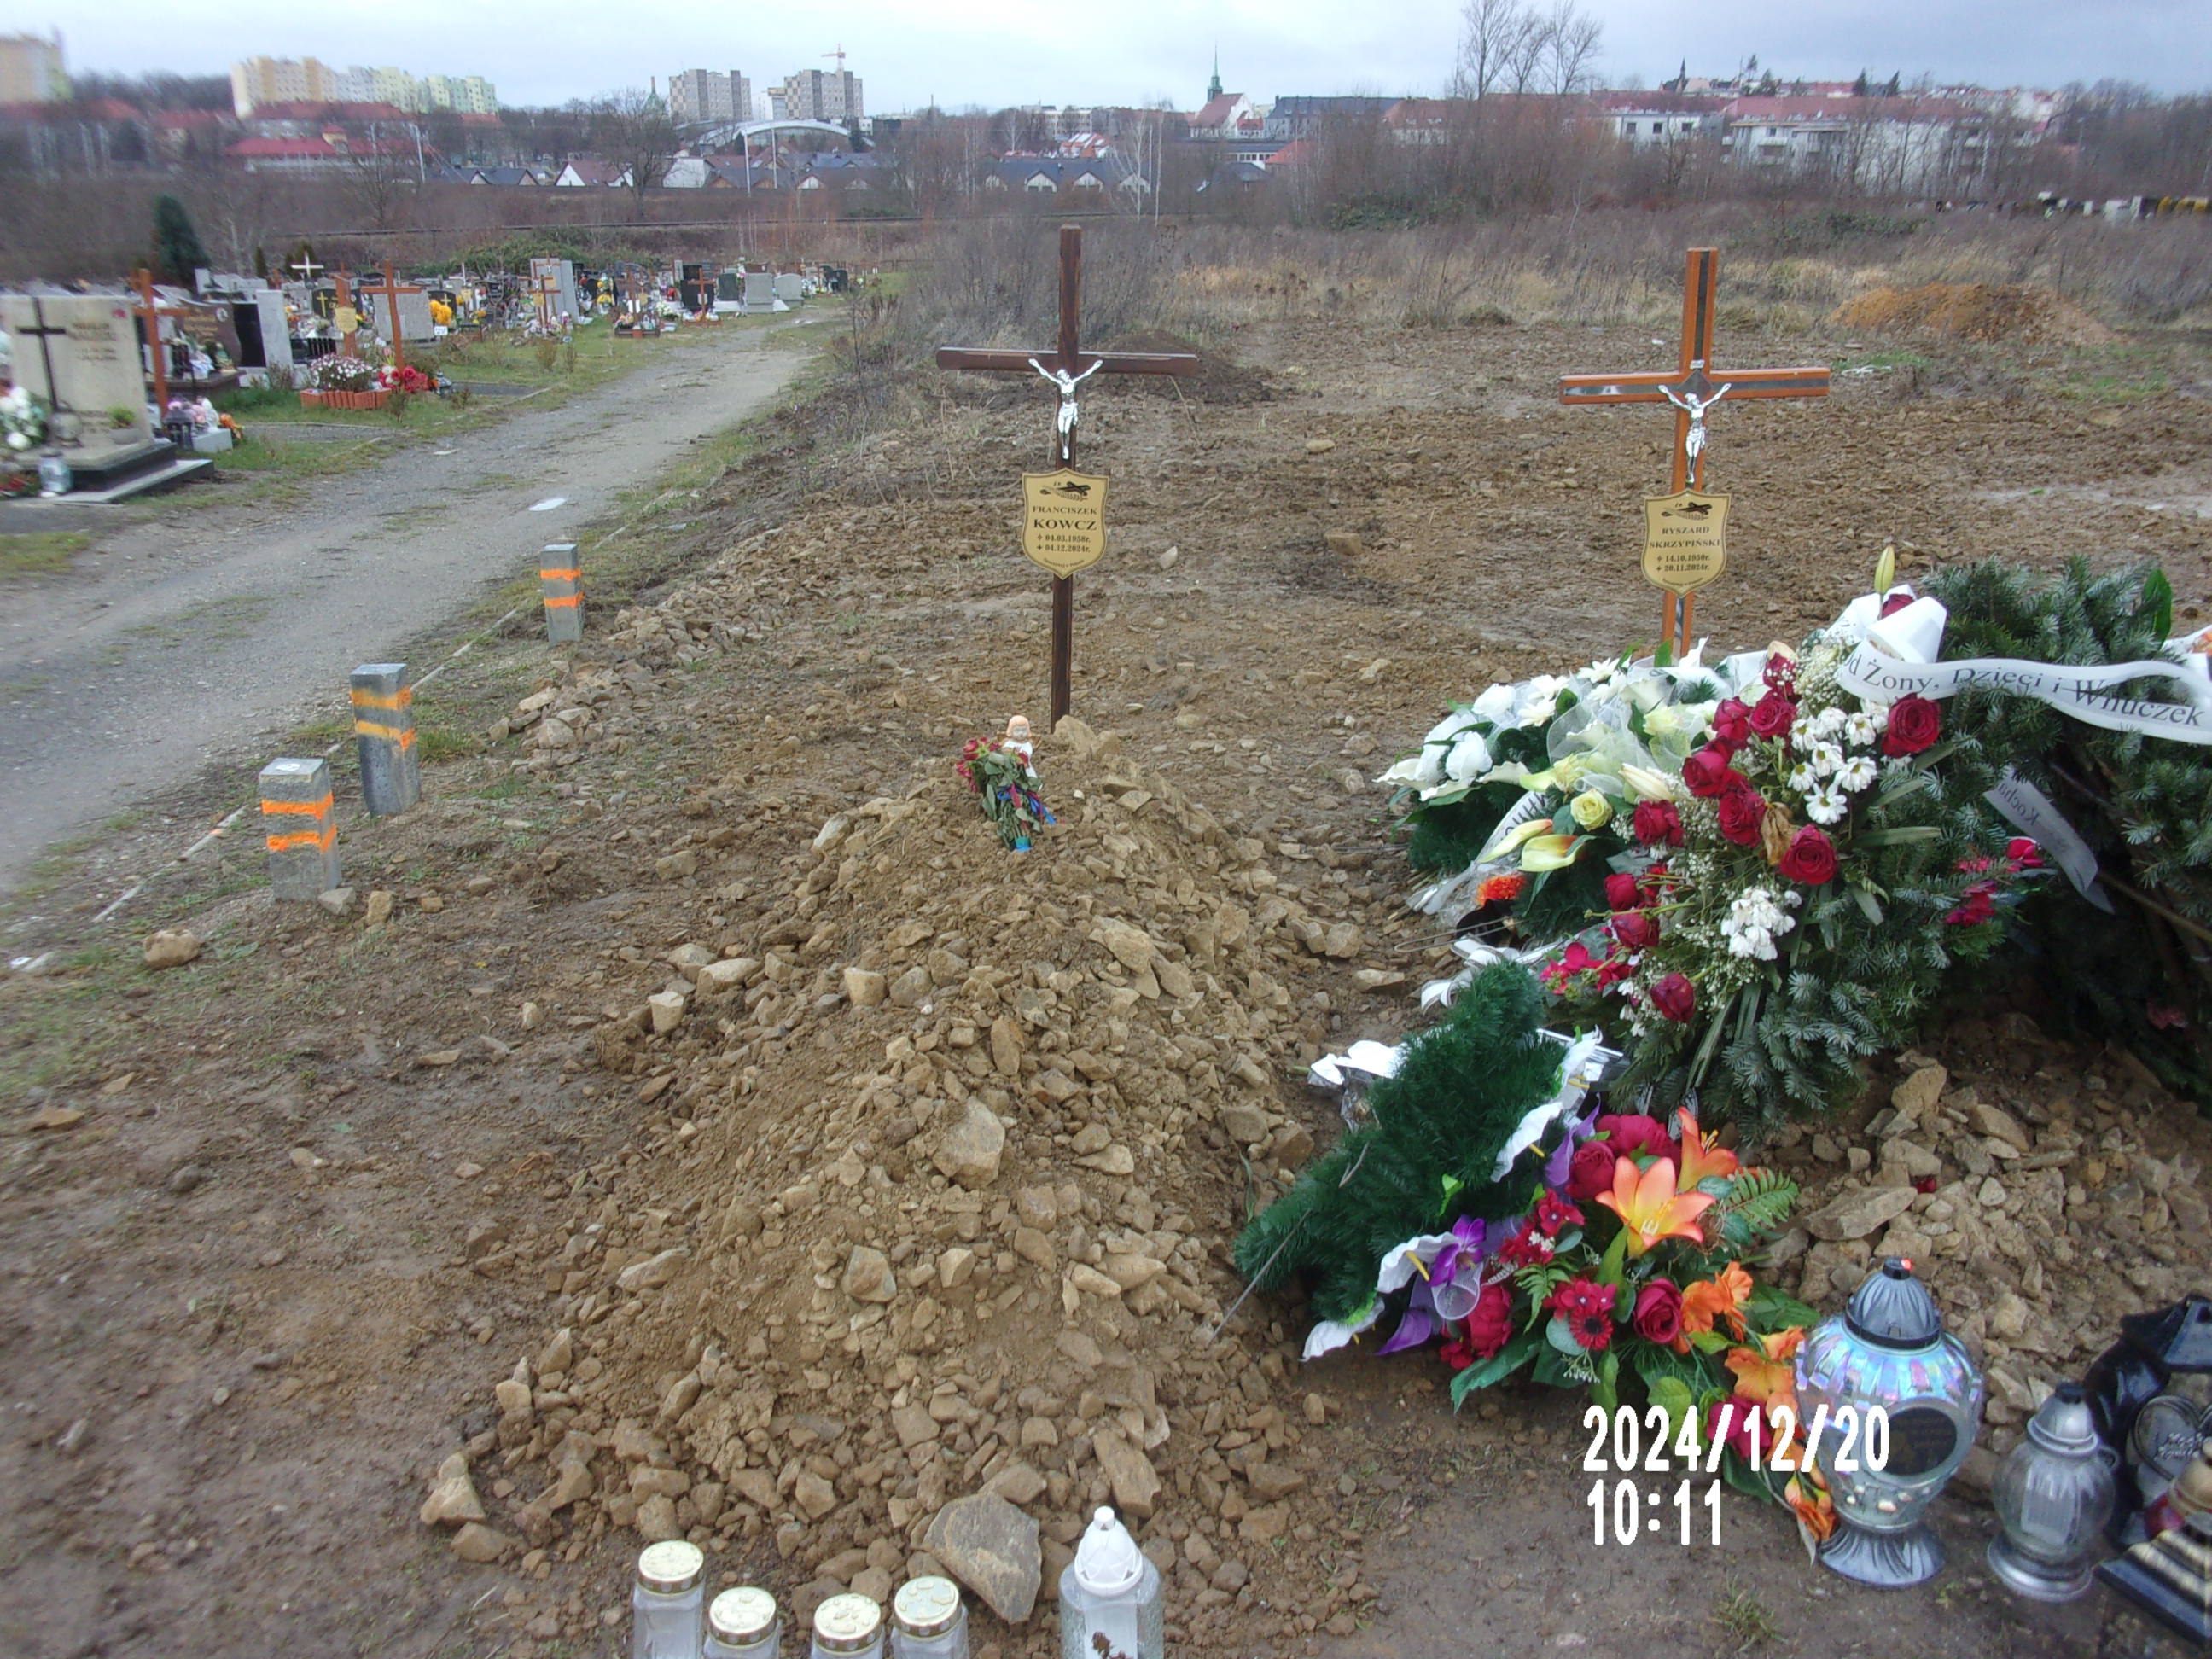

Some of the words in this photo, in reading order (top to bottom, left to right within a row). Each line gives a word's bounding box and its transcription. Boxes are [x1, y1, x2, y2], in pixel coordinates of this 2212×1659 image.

[1033, 505, 1097, 515] FRANCISZEK
[1033, 519, 1097, 530] KOWCZ
[1862, 658, 1939, 694] Żony,
[1952, 666, 2043, 685] Dzieci
[2052, 677, 2063, 693] i
[2075, 679, 2206, 726] Wnuczek
